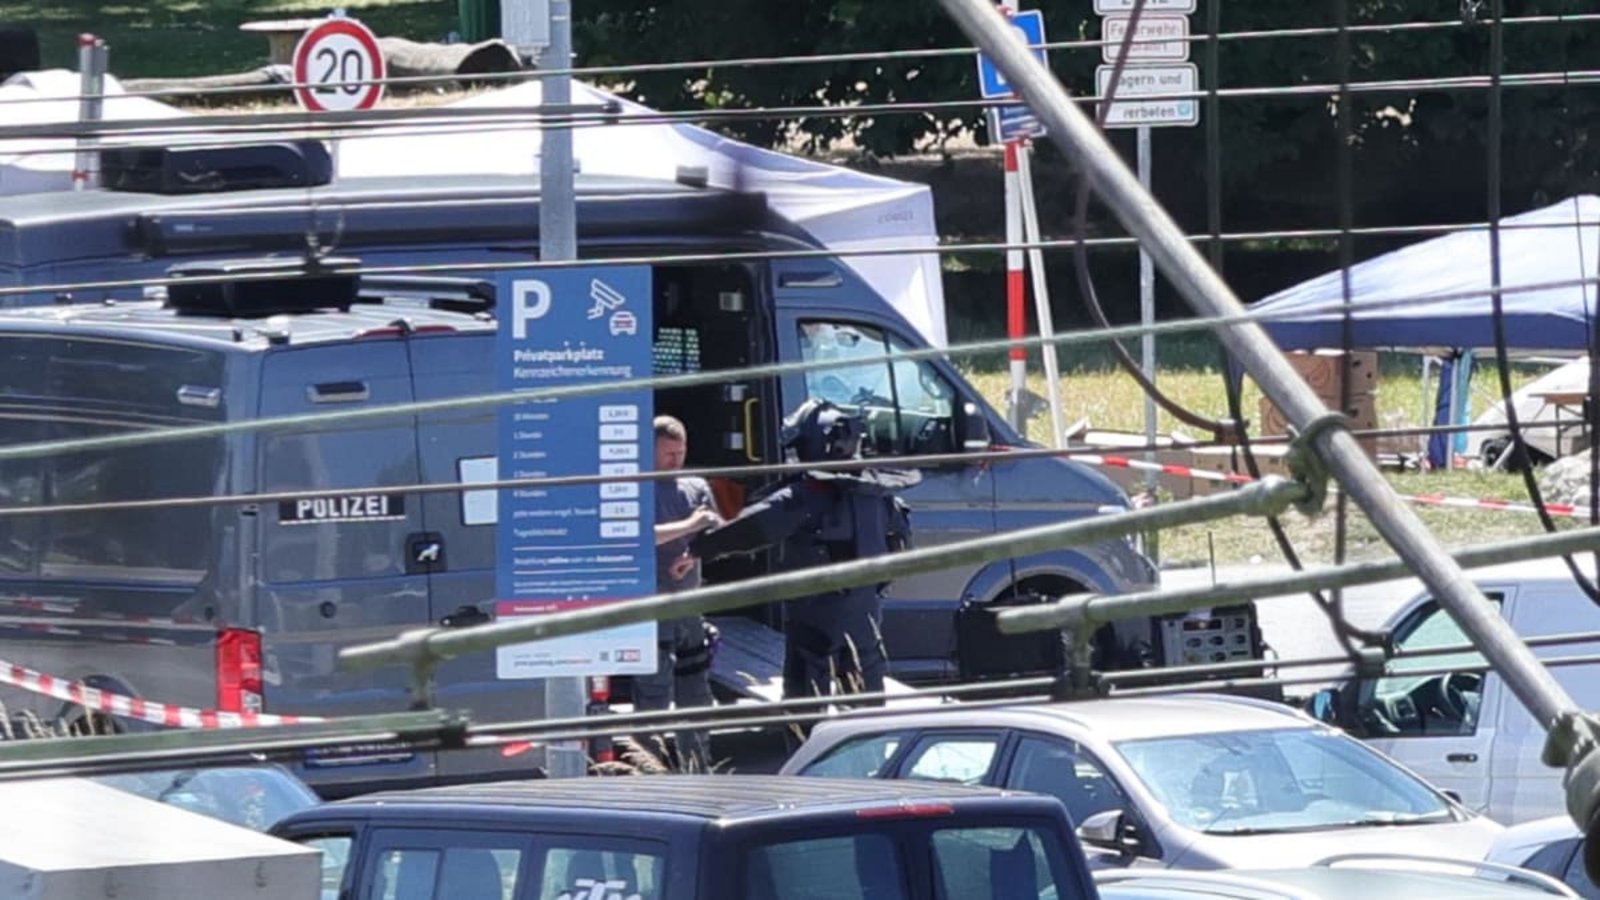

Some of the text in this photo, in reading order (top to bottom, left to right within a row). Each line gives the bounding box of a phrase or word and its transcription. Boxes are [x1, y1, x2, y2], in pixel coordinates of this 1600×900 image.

[316, 47, 363, 96] 20
[1114, 73, 1182, 89] agern und
[512, 279, 551, 339] P
[513, 348, 604, 363] Privatparkplatz
[297, 495, 388, 519] POLIZEI
